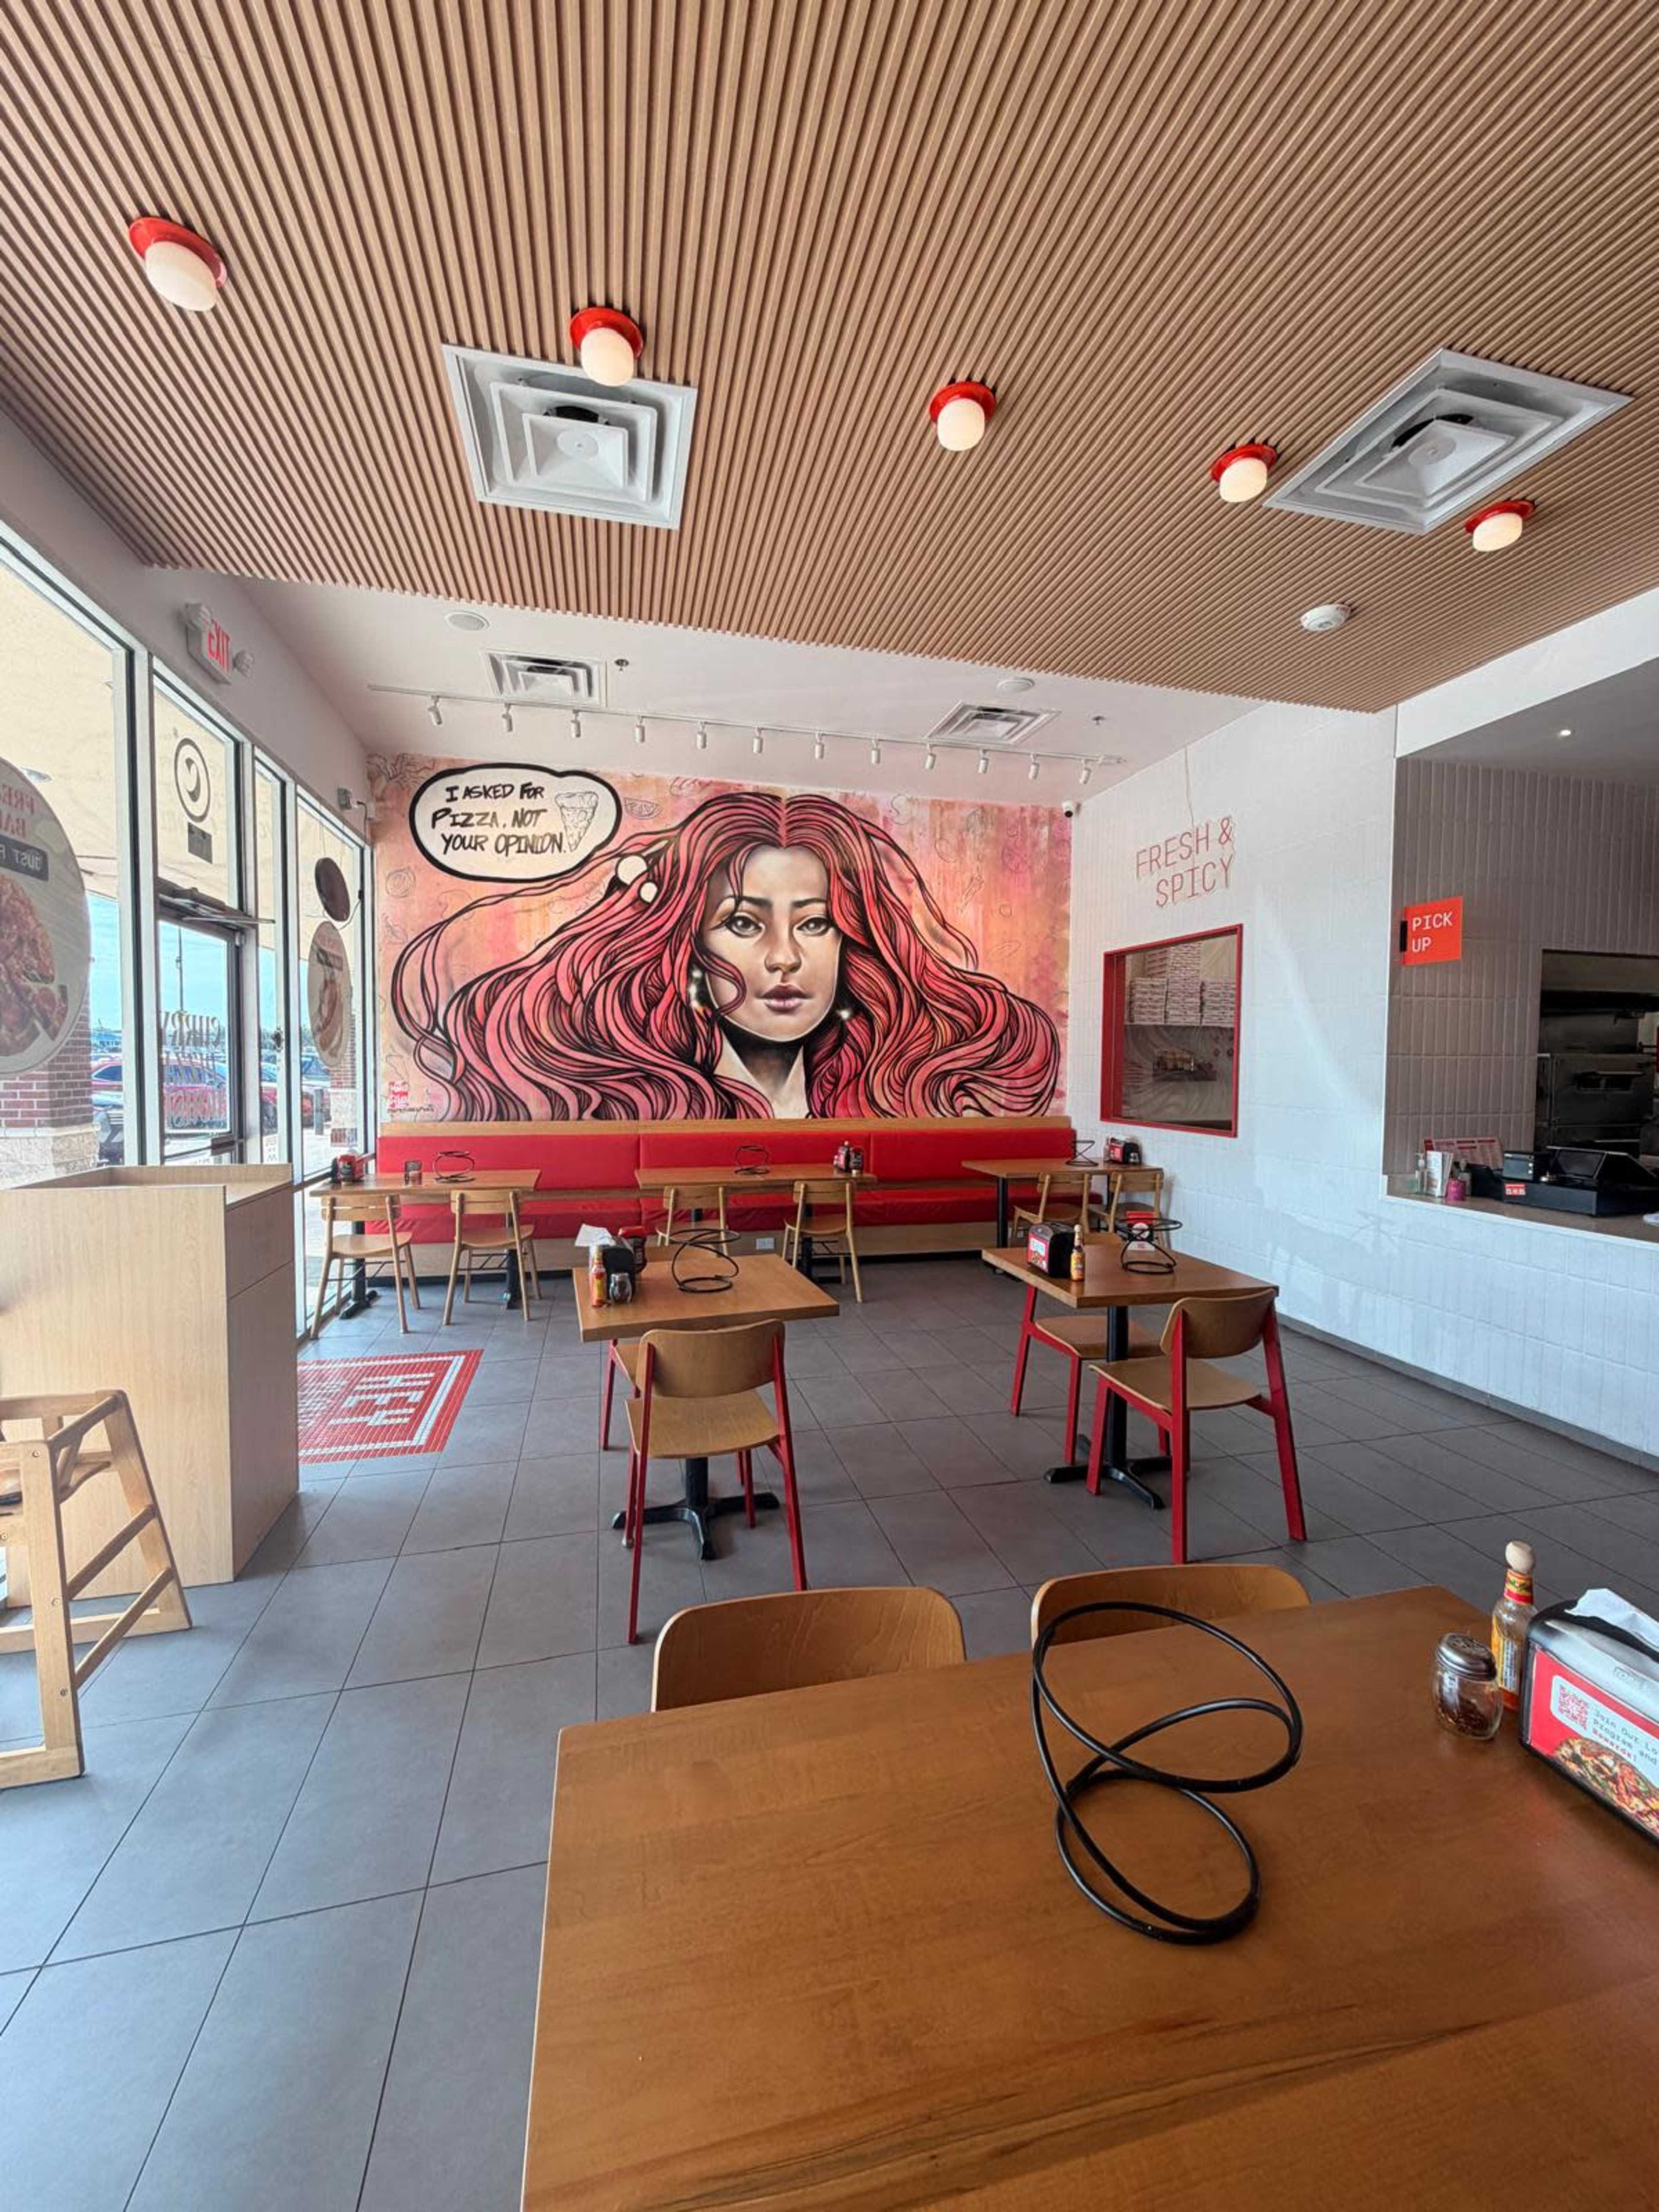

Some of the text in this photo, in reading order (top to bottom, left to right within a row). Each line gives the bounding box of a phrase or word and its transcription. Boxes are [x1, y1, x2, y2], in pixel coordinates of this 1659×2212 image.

[207, 618, 231, 674] EXIT
[445, 782, 545, 802] I ASKED FOR
[512, 807, 548, 828] NOT
[441, 832, 566, 857] YOUR OPINION.
[1136, 817, 1232, 879] FRESH &
[1156, 854, 1233, 907] SPICY
[1412, 911, 1453, 931] PICK
[1412, 936, 1432, 953] UP
[1594, 1710, 1617, 1728] Join
[1639, 1750, 1657, 1765] and
